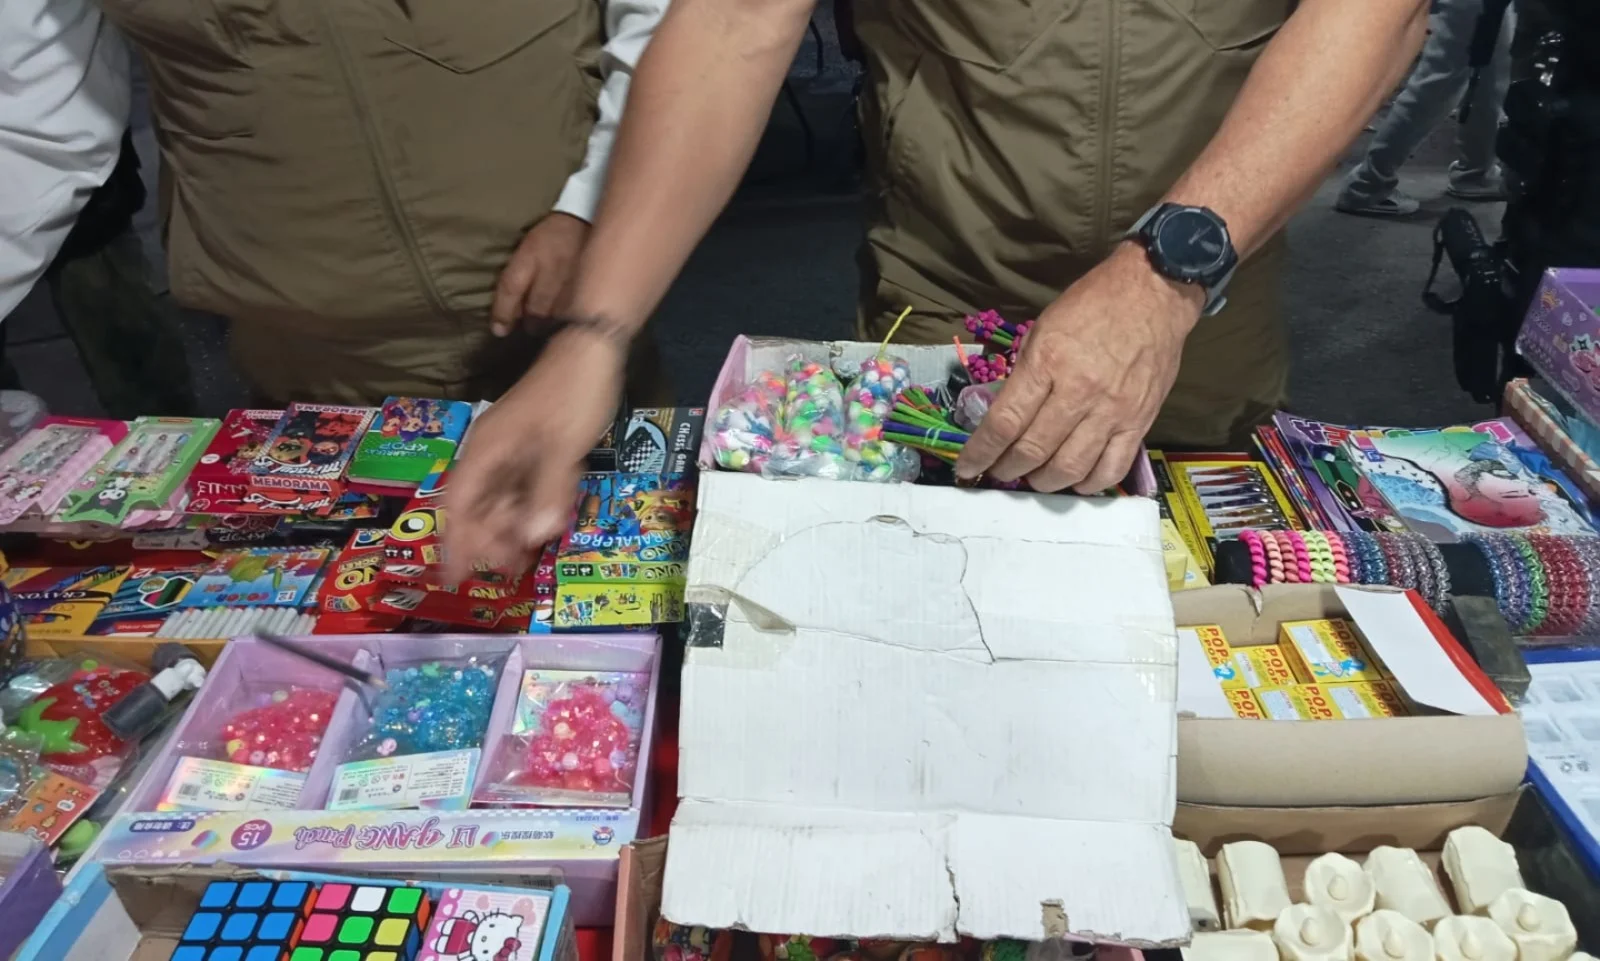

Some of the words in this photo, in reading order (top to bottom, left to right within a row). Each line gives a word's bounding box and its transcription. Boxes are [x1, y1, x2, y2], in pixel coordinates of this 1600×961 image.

[295, 403, 368, 416] MEMORAMA
[251, 475, 332, 491] MEMORAMA
[642, 564, 682, 581] UNO
[277, 591, 295, 603] 12
[1206, 627, 1229, 657] POP
[1332, 621, 1358, 651] POP
[1204, 638, 1220, 664] POP
[1263, 660, 1280, 685] POP
[1265, 648, 1289, 677] POP
[1306, 686, 1333, 717] POP
[243, 822, 268, 831] PCS
[240, 832, 262, 847] 15
